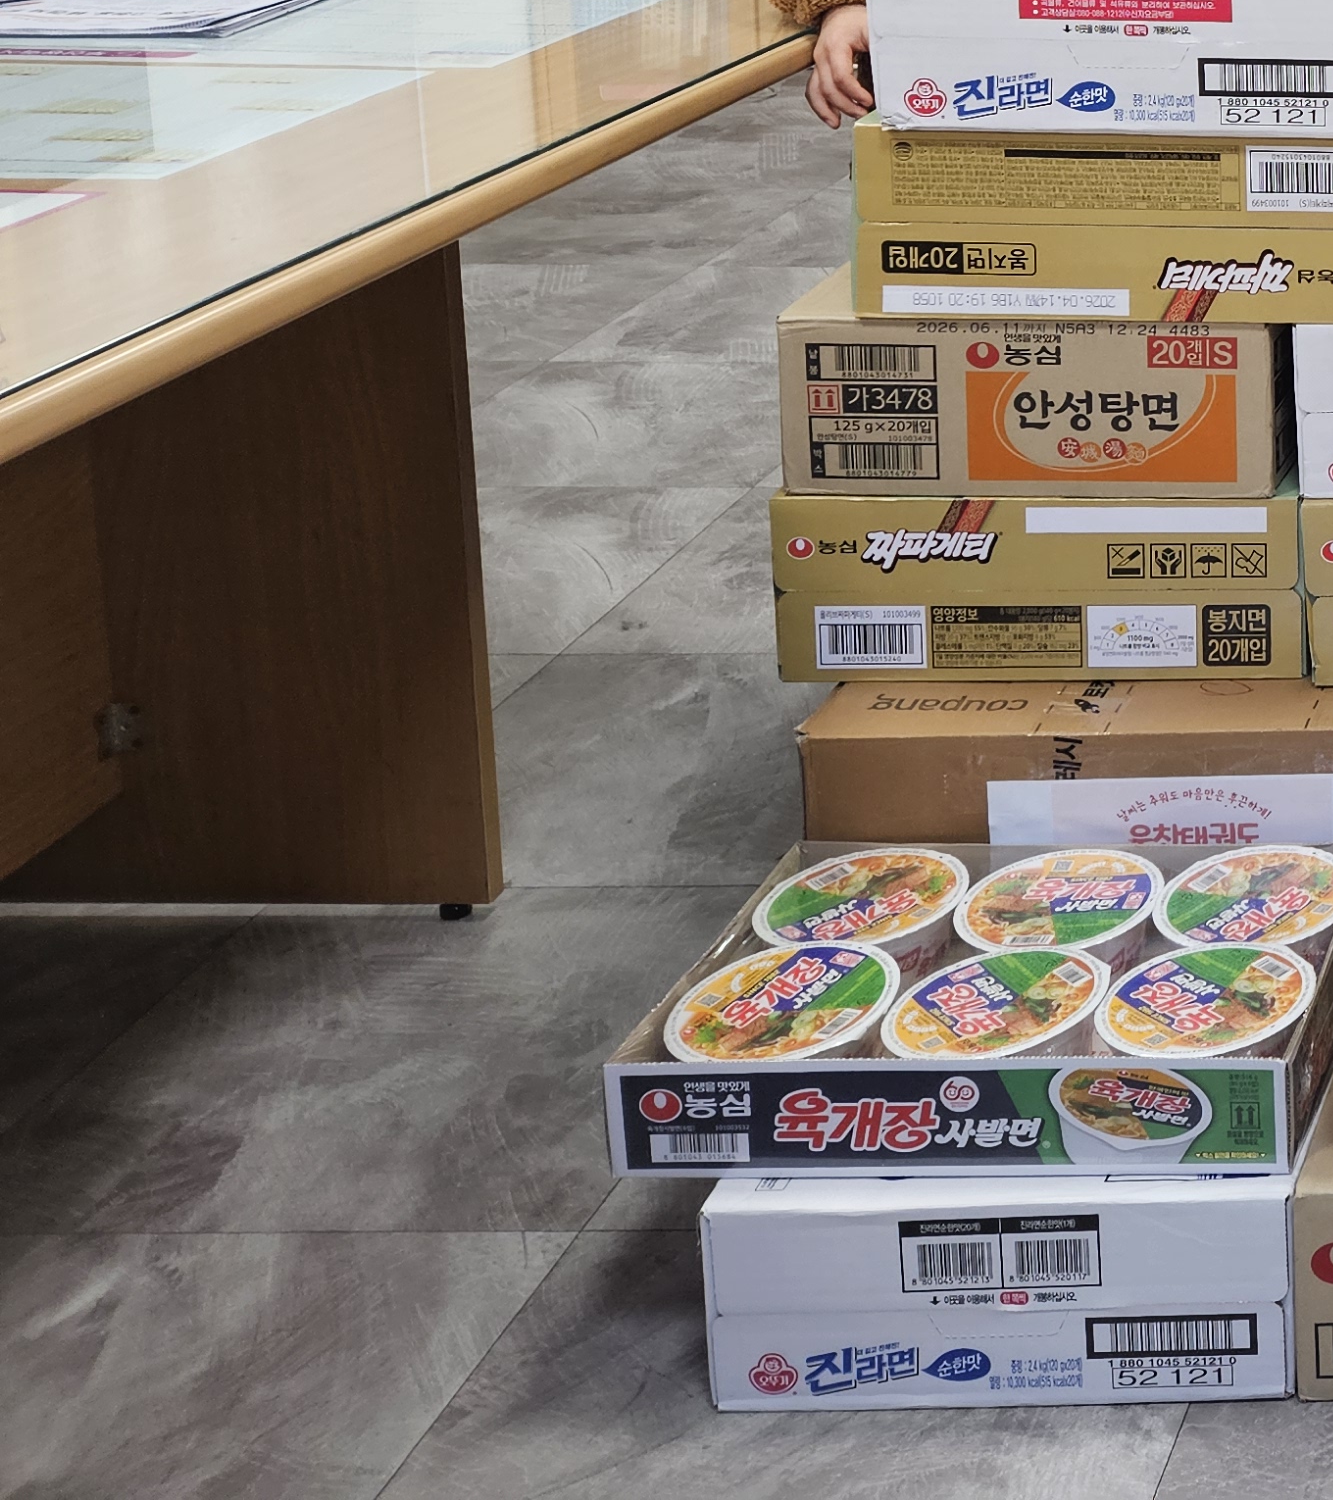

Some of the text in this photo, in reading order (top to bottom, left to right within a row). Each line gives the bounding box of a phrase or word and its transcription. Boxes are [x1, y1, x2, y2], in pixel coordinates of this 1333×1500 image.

[952, 73, 1055, 122] 진라면
[1067, 82, 1110, 109] 순한맛
[1224, 107, 1325, 126] 52 121
[845, 385, 935, 412] 가3478
[1012, 388, 1182, 434] 안성탕면
[861, 529, 999, 574] 짜파게티
[1206, 608, 1268, 632] 봉지면
[1207, 639, 1268, 664] 20개입
[868, 692, 1029, 714] coupang
[684, 1094, 752, 1119] 농심
[773, 1087, 1044, 1153] 육개장 사발면
[804, 1343, 982, 1397] 진라면 순한맛
